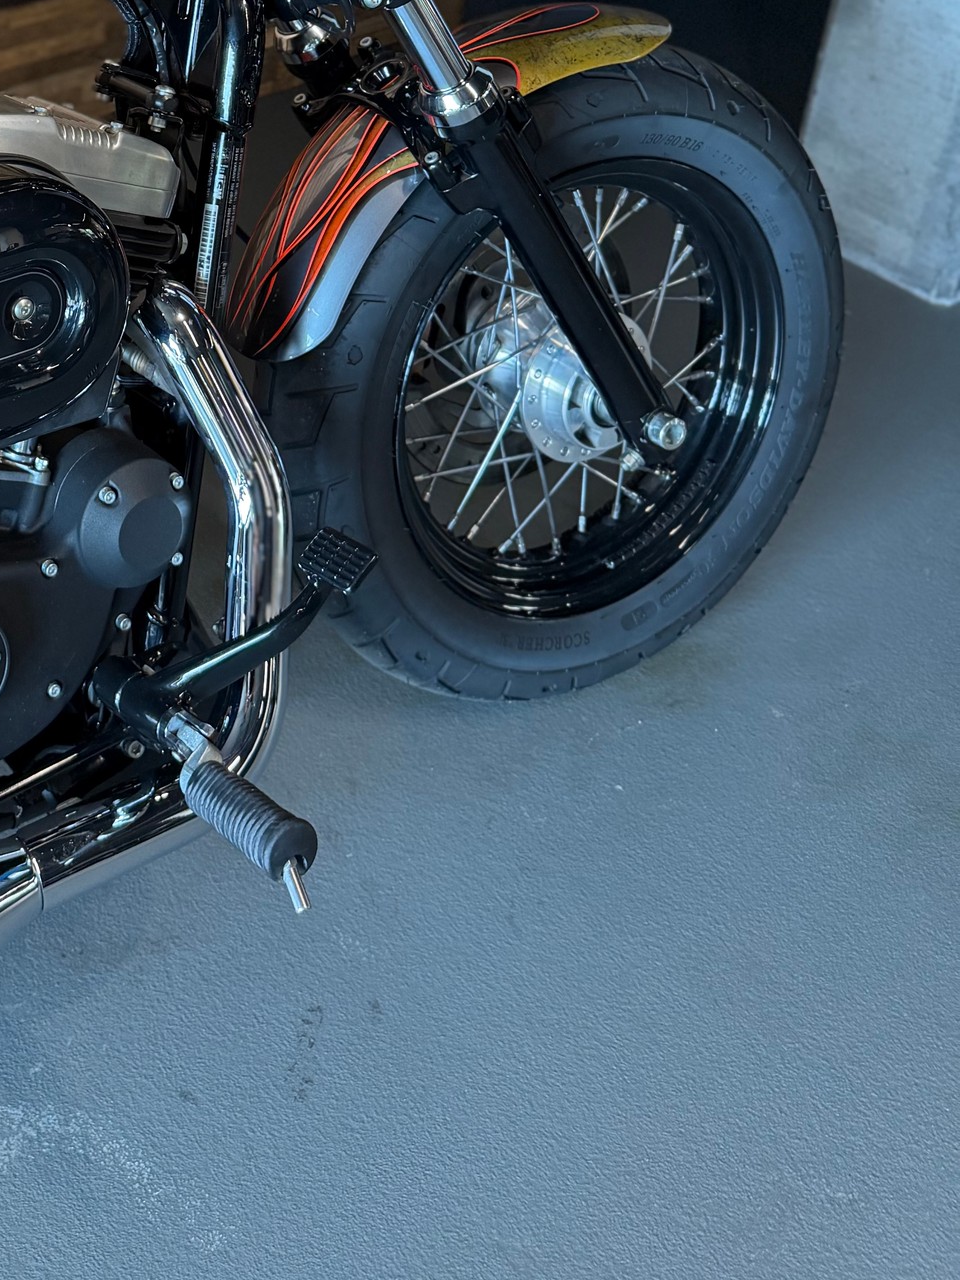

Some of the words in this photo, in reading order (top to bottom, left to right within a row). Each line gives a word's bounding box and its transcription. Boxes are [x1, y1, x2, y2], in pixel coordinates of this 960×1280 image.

[641, 132, 681, 148] 130/90
[678, 136, 705, 154] B16
[516, 631, 591, 652] SCORCHER
